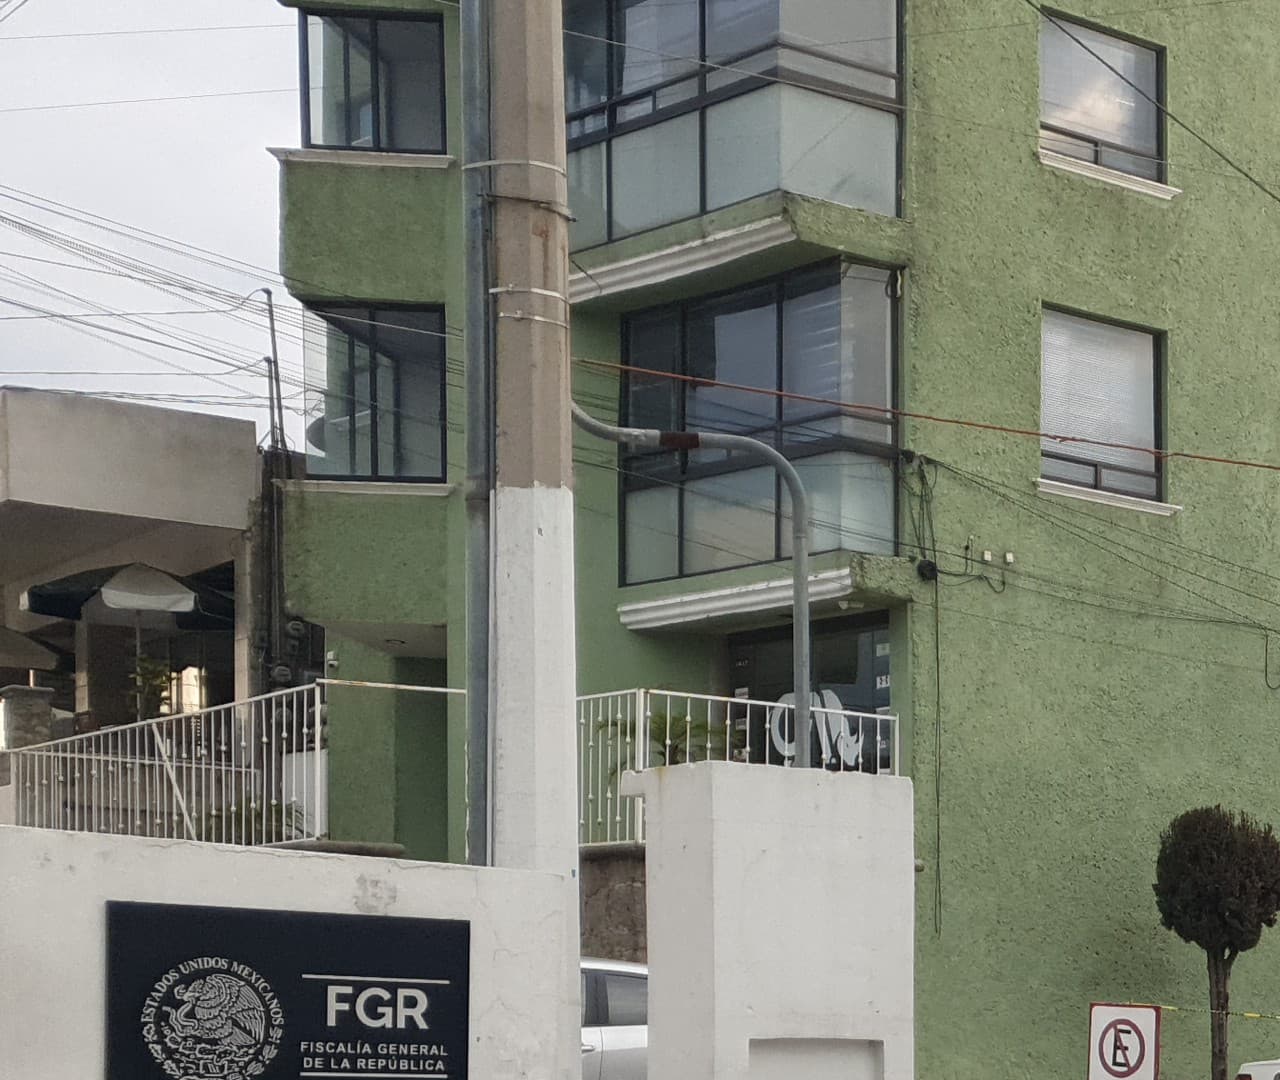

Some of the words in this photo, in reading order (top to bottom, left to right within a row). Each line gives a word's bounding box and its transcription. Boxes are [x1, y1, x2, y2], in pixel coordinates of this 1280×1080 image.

[140, 969, 180, 1022] ESTADOS
[178, 957, 229, 974] UNIDOS
[230, 961, 284, 1025] MEXICANOS
[326, 985, 430, 1030] FGR
[300, 1040, 372, 1054] FISCALÍA
[377, 1043, 449, 1056] GENERAL
[303, 1057, 325, 1069] DE
[331, 1057, 351, 1070] LA
[356, 1056, 446, 1071] REPÚBLICA
[1112, 1029, 1132, 1067] E
